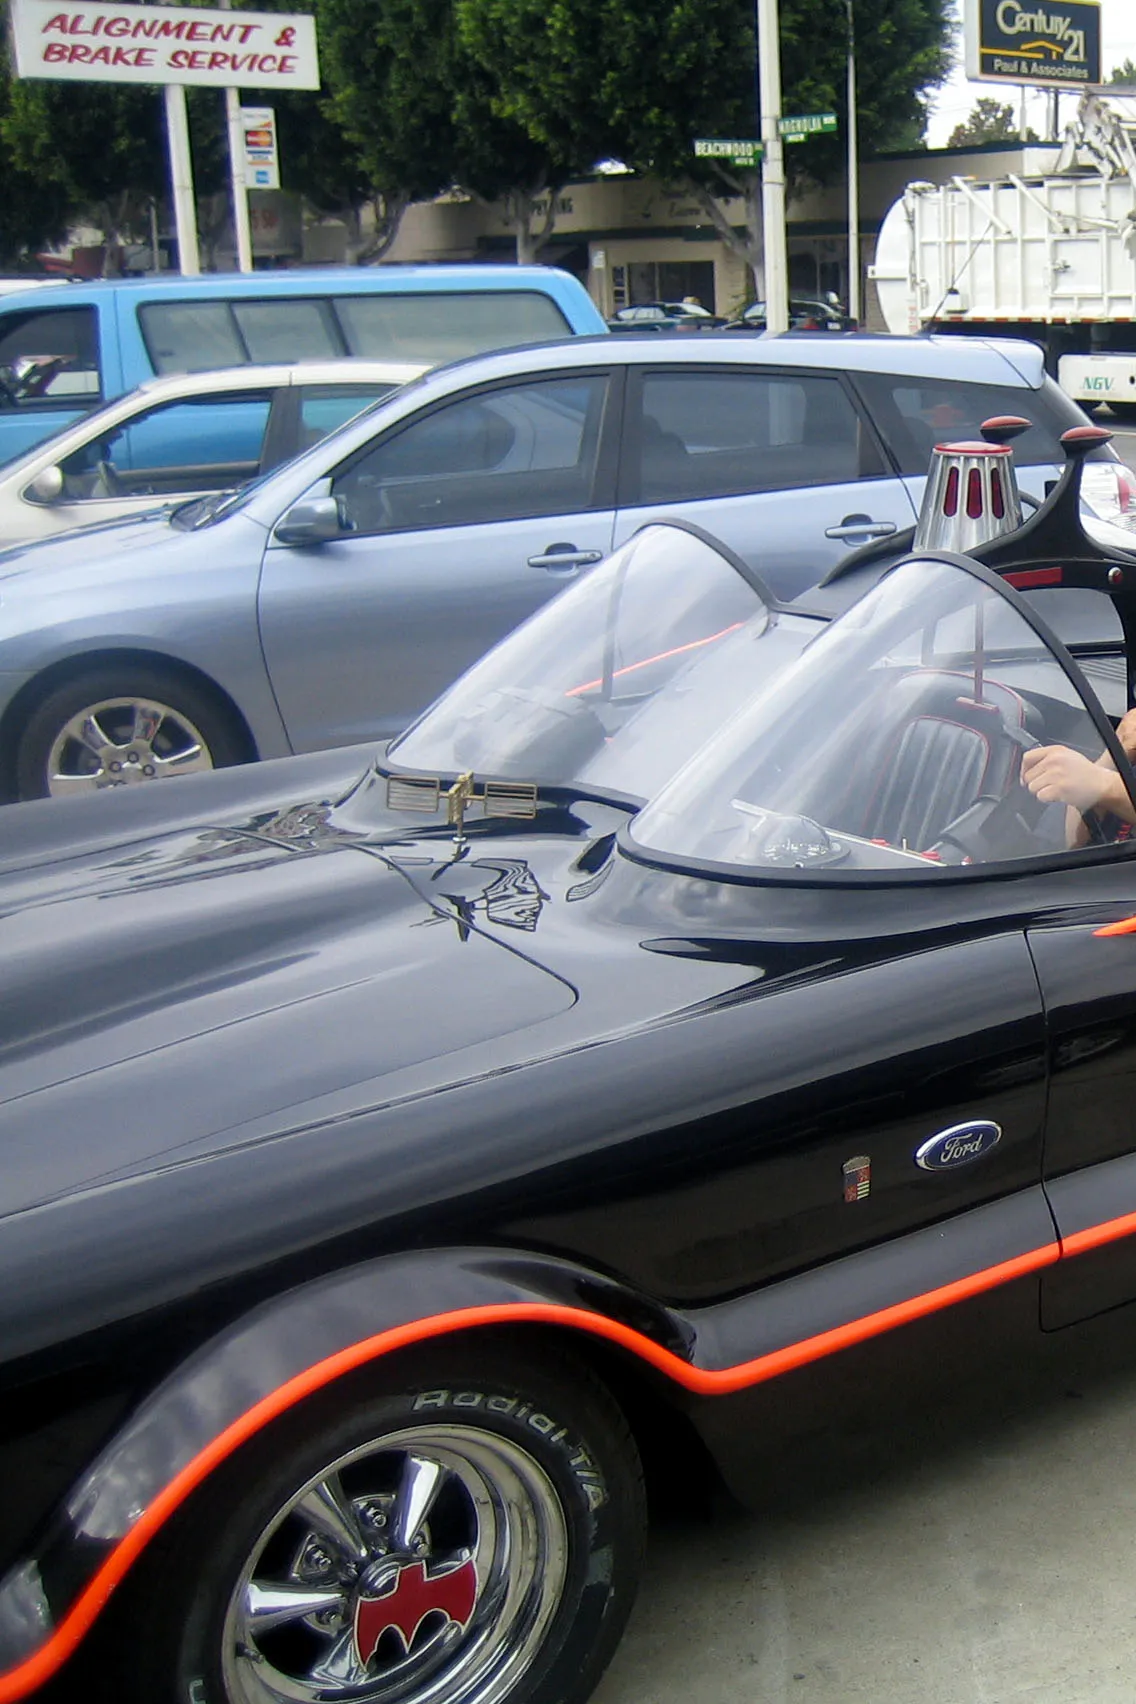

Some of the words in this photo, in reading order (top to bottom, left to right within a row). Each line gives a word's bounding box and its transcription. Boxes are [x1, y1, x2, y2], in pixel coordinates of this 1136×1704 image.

[42, 13, 263, 44] ALIGNMENT
[274, 26, 297, 47] &
[996, 0, 1071, 40] Century
[1063, 30, 1088, 62] 21
[42, 43, 158, 67] BRAKE
[166, 50, 299, 73] SERVICE
[994, 59, 1018, 73] Paul
[1019, 62, 1029, 74] &
[1031, 62, 1088, 78] Associates
[695, 140, 754, 157] BEACHWOOD
[1083, 377, 1114, 390] NGV
[940, 1133, 983, 1163] Ford
[411, 1389, 568, 1442] Radial
[569, 1446, 609, 1513] T/A
